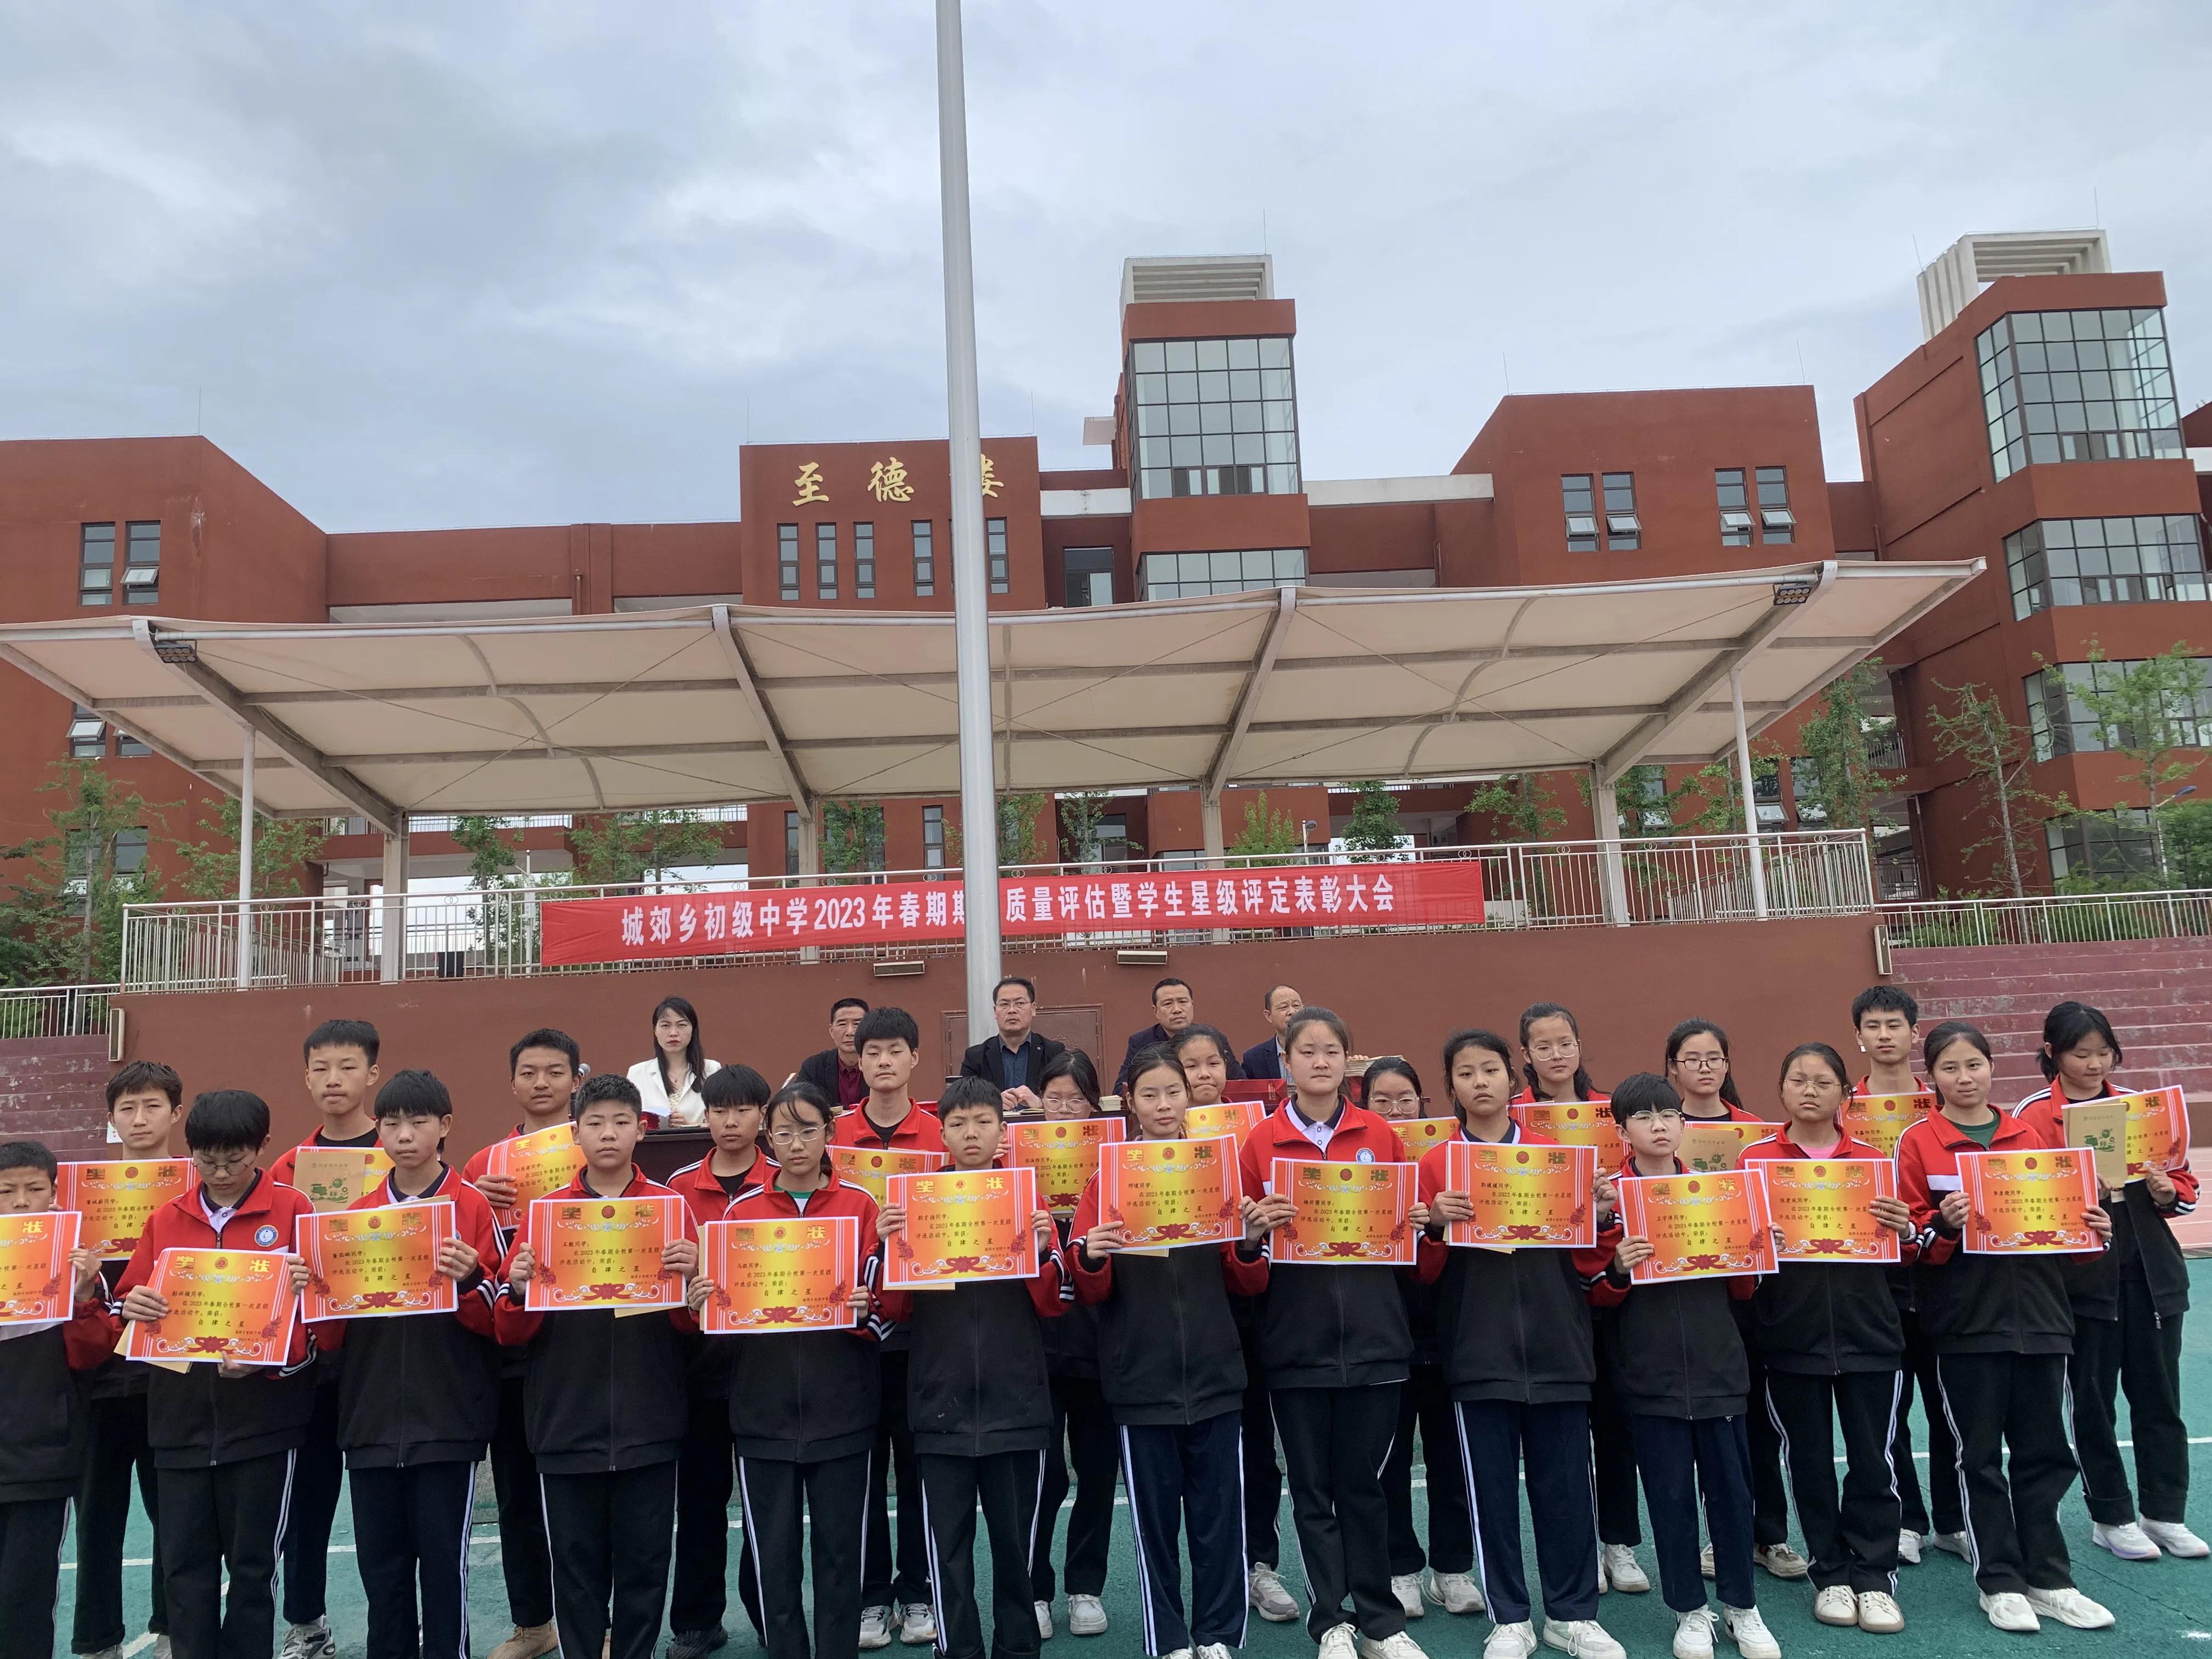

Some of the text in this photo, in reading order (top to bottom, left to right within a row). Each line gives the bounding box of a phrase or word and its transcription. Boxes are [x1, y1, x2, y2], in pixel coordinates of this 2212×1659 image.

[622, 873, 1395, 947] 城郊乡初级中学2023年春期期质量评估暨学生星级评定表彰大会
